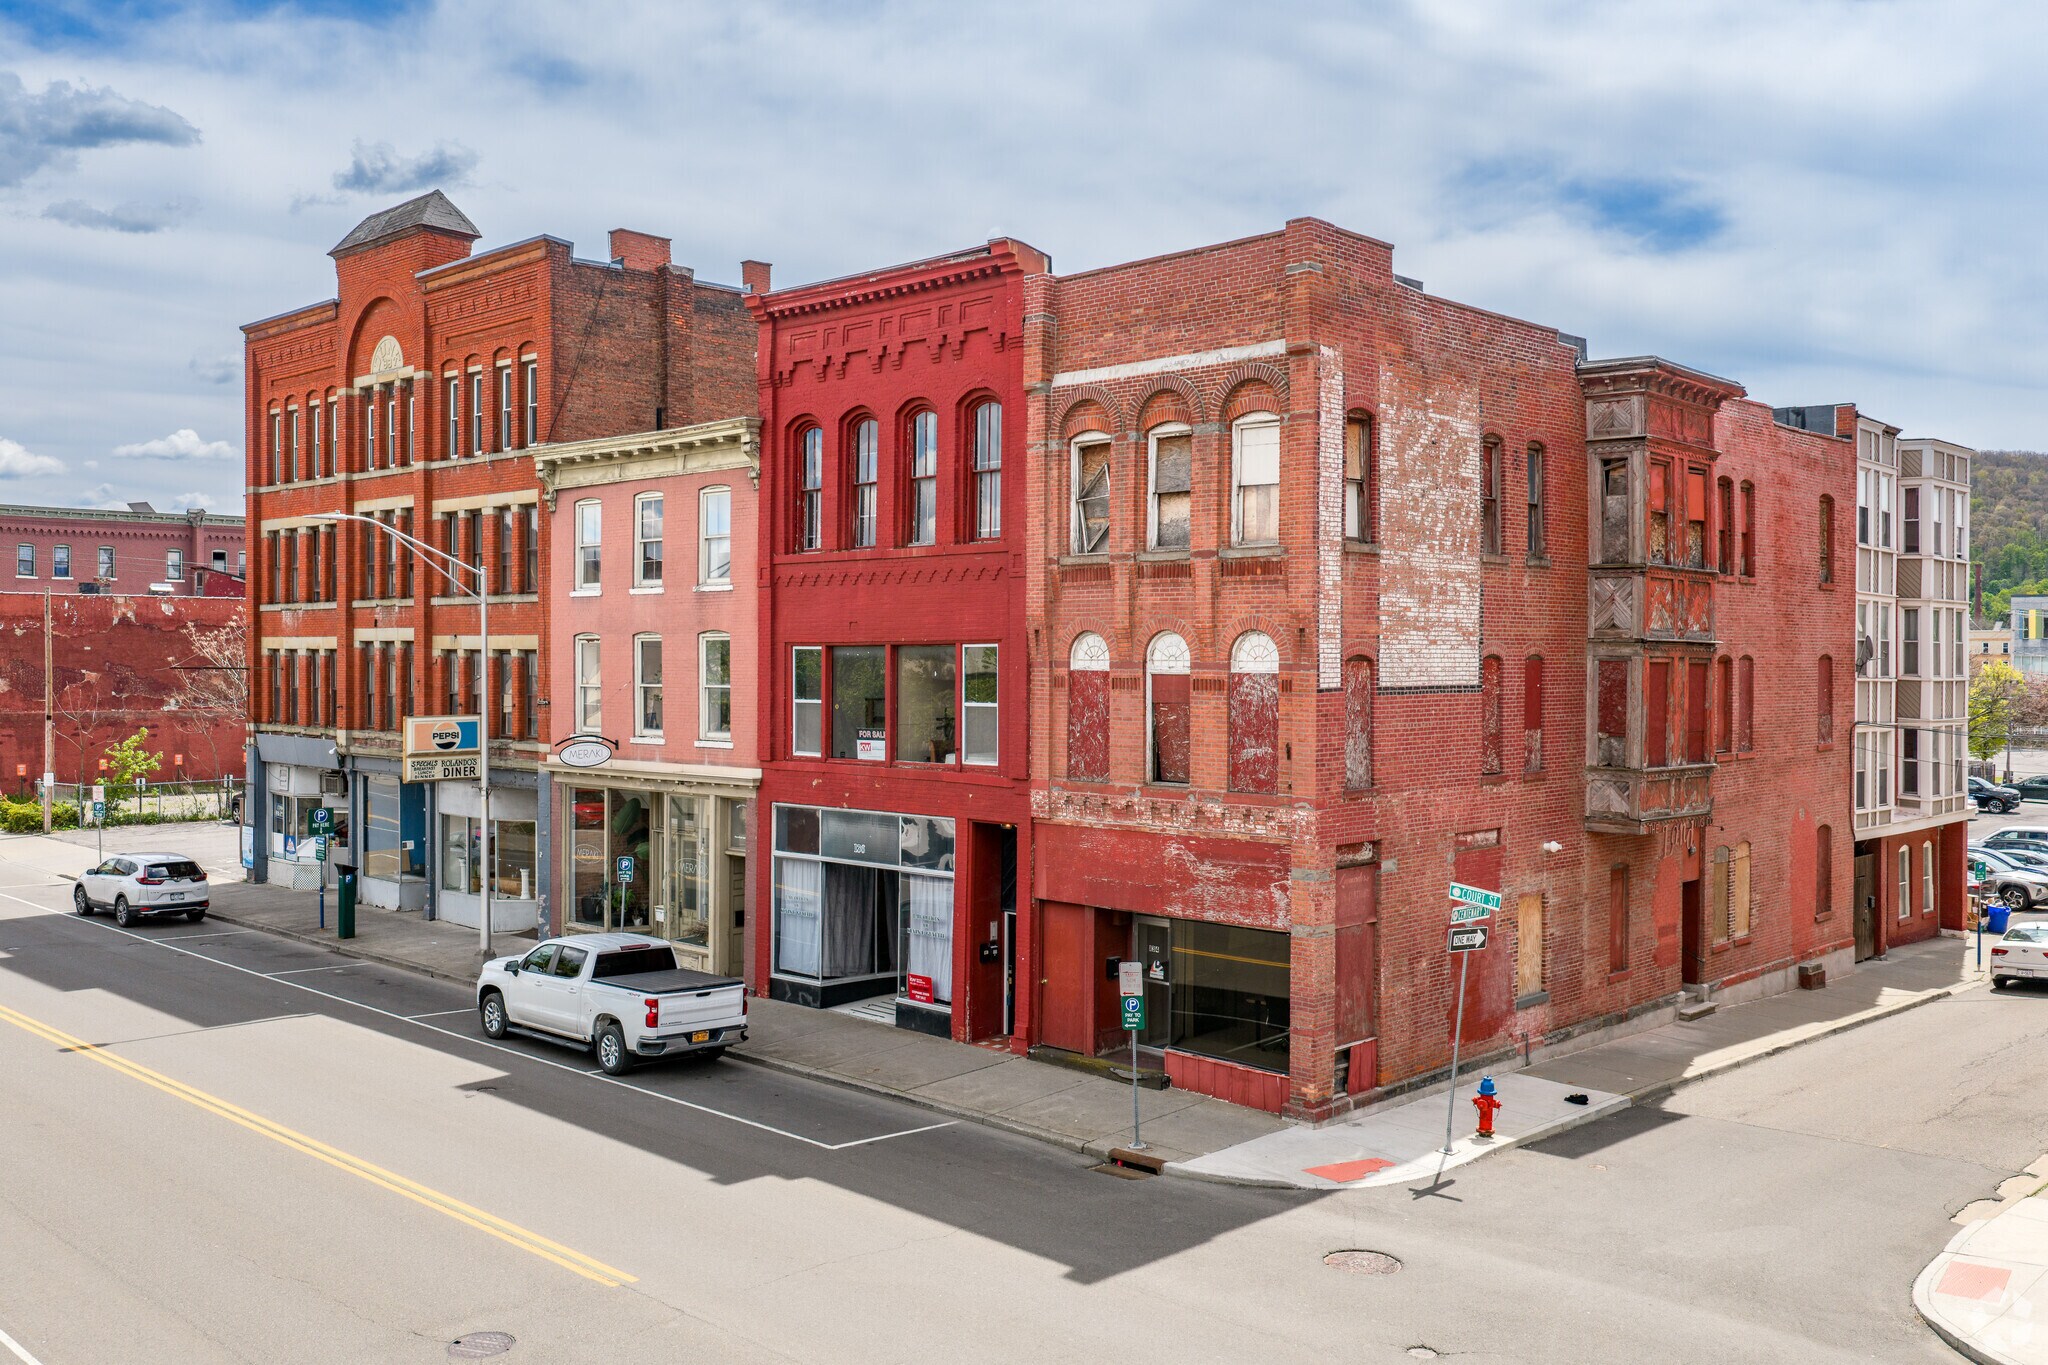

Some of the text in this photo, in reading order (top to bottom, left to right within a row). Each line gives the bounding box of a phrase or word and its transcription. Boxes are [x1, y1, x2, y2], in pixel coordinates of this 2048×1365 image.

[432, 731, 459, 740] PEPSI
[858, 730, 871, 738] FOR
[569, 749, 604, 759] MERAKI
[411, 759, 438, 768] SPECIALS
[441, 757, 477, 767] ROLANDO'S
[443, 766, 476, 777] DINER
[317, 811, 325, 821] P
[621, 860, 629, 869] P
[1462, 888, 1497, 907] COURT ST
[1454, 934, 1477, 945] ONE WAY
[1129, 1000, 1137, 1010] P
